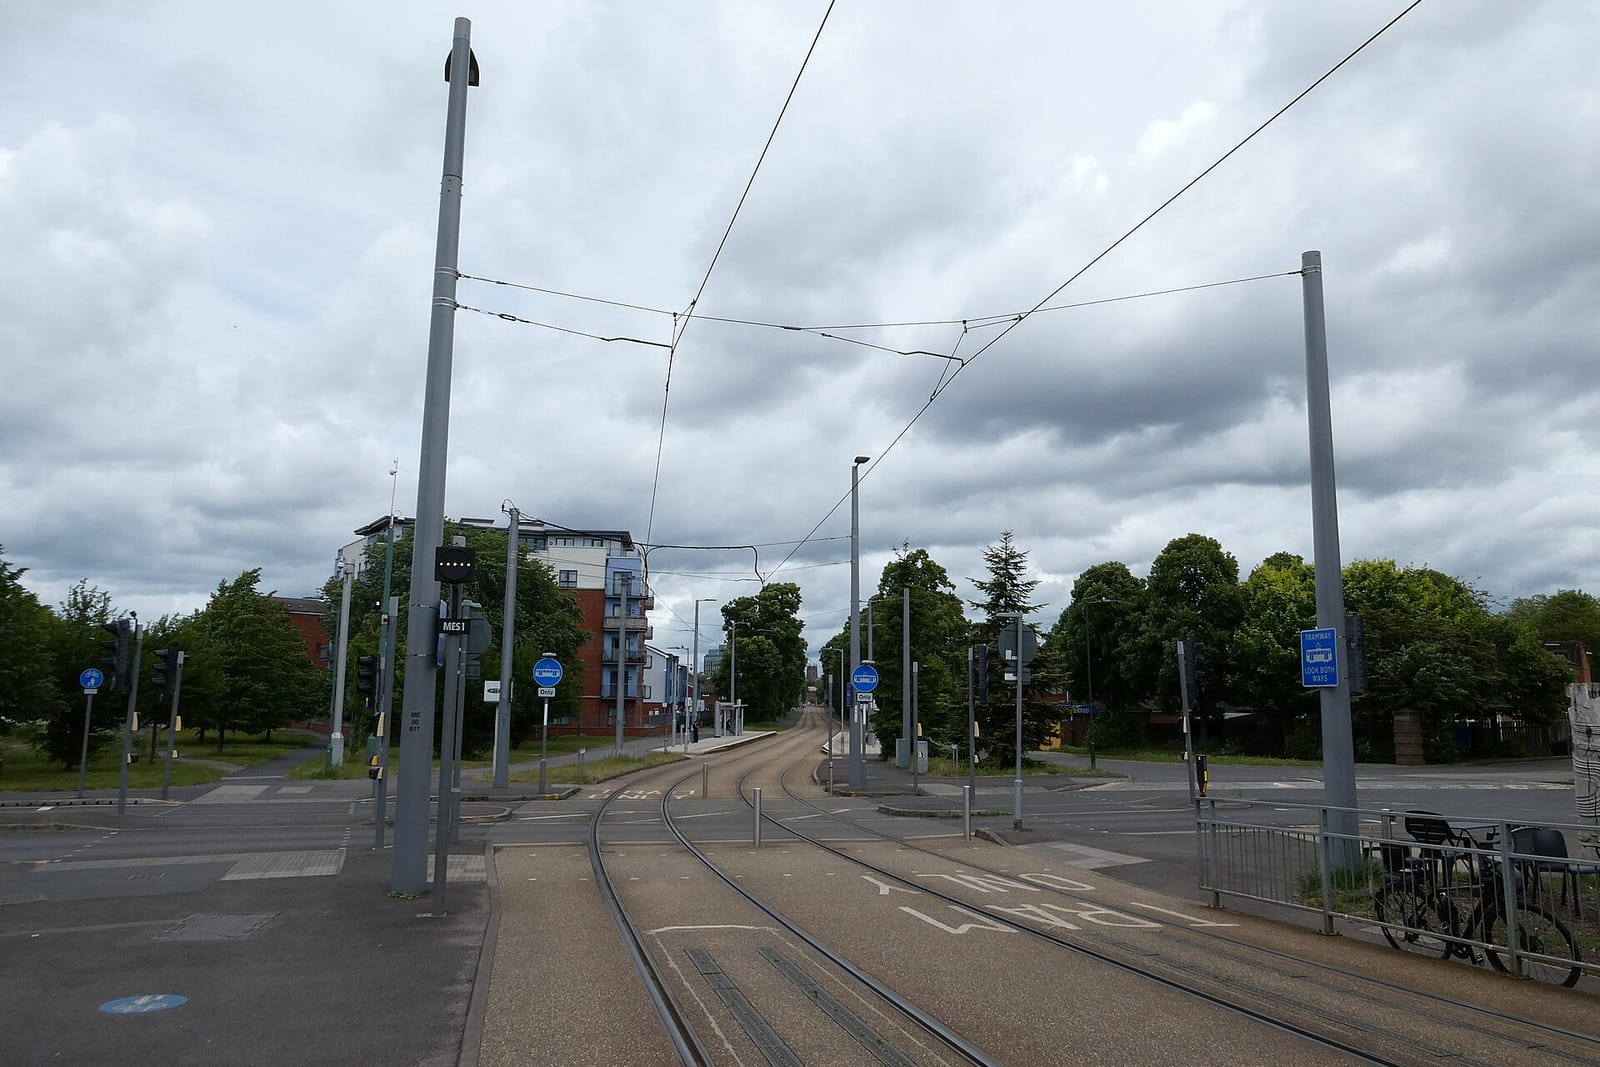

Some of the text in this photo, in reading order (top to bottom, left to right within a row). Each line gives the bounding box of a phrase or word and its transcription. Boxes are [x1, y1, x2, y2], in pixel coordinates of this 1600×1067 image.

[443, 621, 465, 631] MES1
[860, 873, 1096, 895] ONLY
[899, 902, 1240, 934] TRAM
